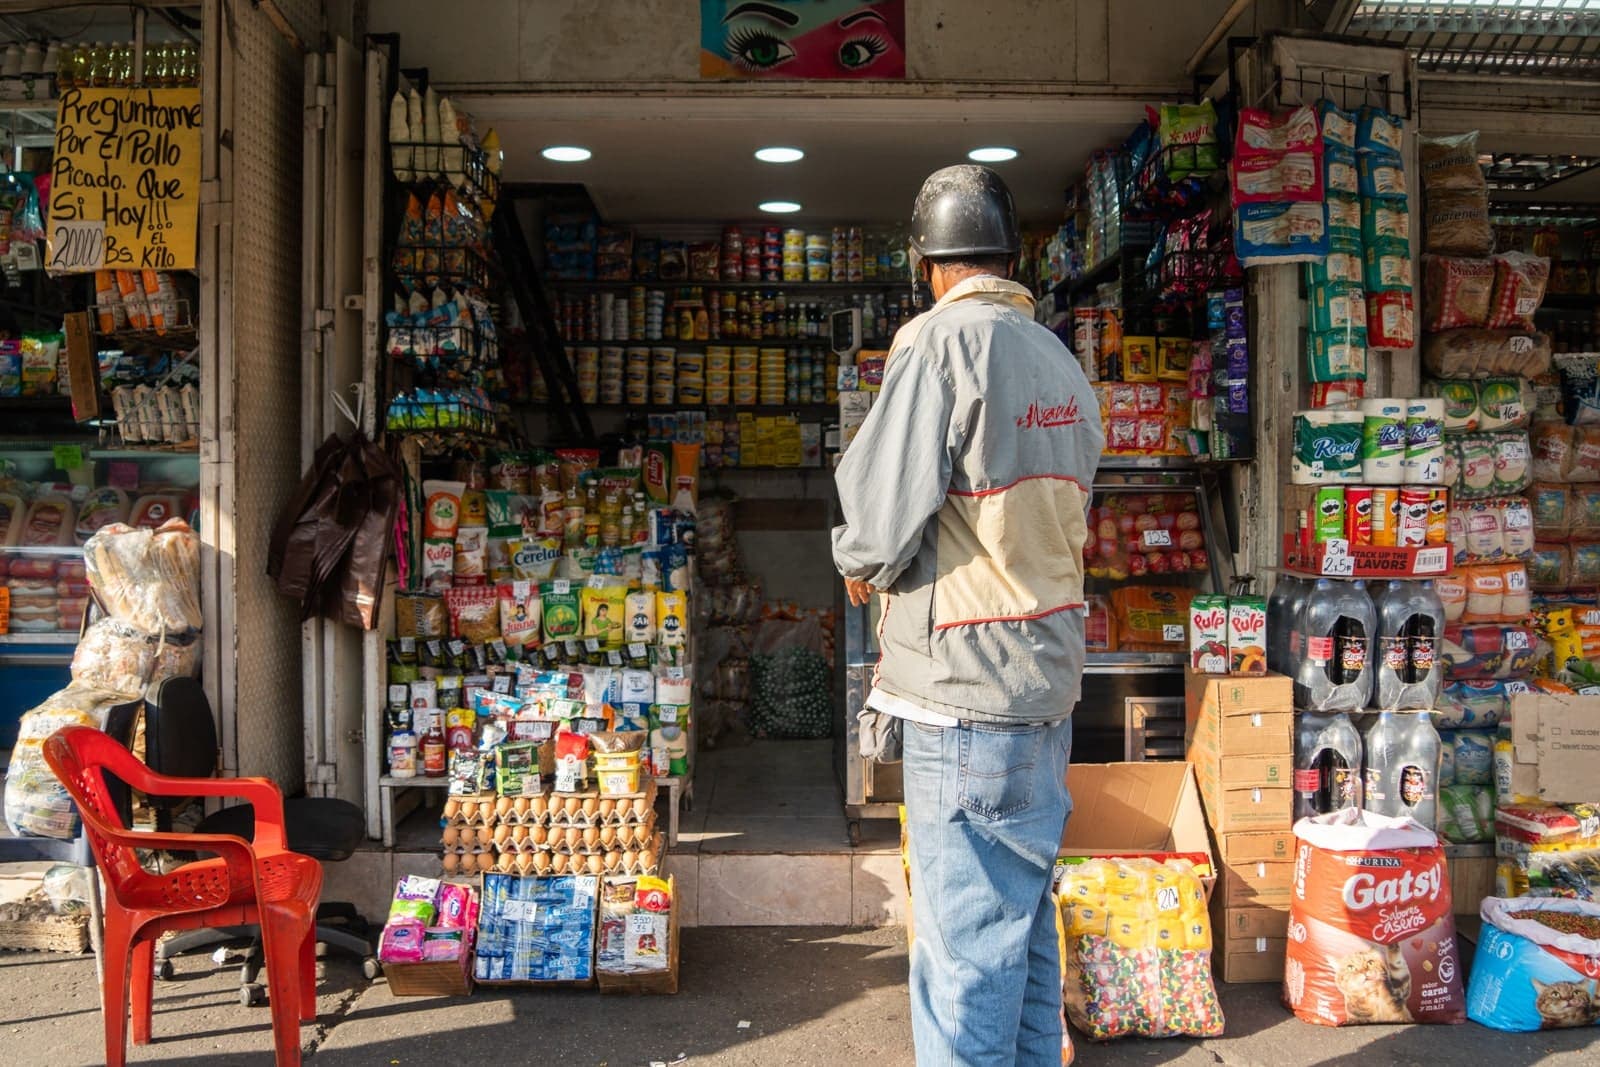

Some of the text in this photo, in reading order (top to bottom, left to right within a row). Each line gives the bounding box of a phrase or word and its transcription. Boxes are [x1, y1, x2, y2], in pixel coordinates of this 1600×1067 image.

[56, 125, 180, 166] Por El Pollo
[53, 156, 184, 200] Picado. Que
[52, 191, 173, 239] Si Hay!!!
[151, 231, 167, 245] EL
[141, 246, 175, 268] Kilo
[1312, 436, 1361, 459] Rosal
[1354, 558, 1407, 570] LAVORS
[1193, 610, 1225, 633] Pulp
[1232, 612, 1265, 634] Pulp
[1358, 857, 1400, 867] PURINA
[1343, 862, 1441, 911] Gatsy
[1378, 905, 1420, 923] Sabores
[1372, 912, 1427, 941] Caseros
[1421, 986, 1448, 998] carne
